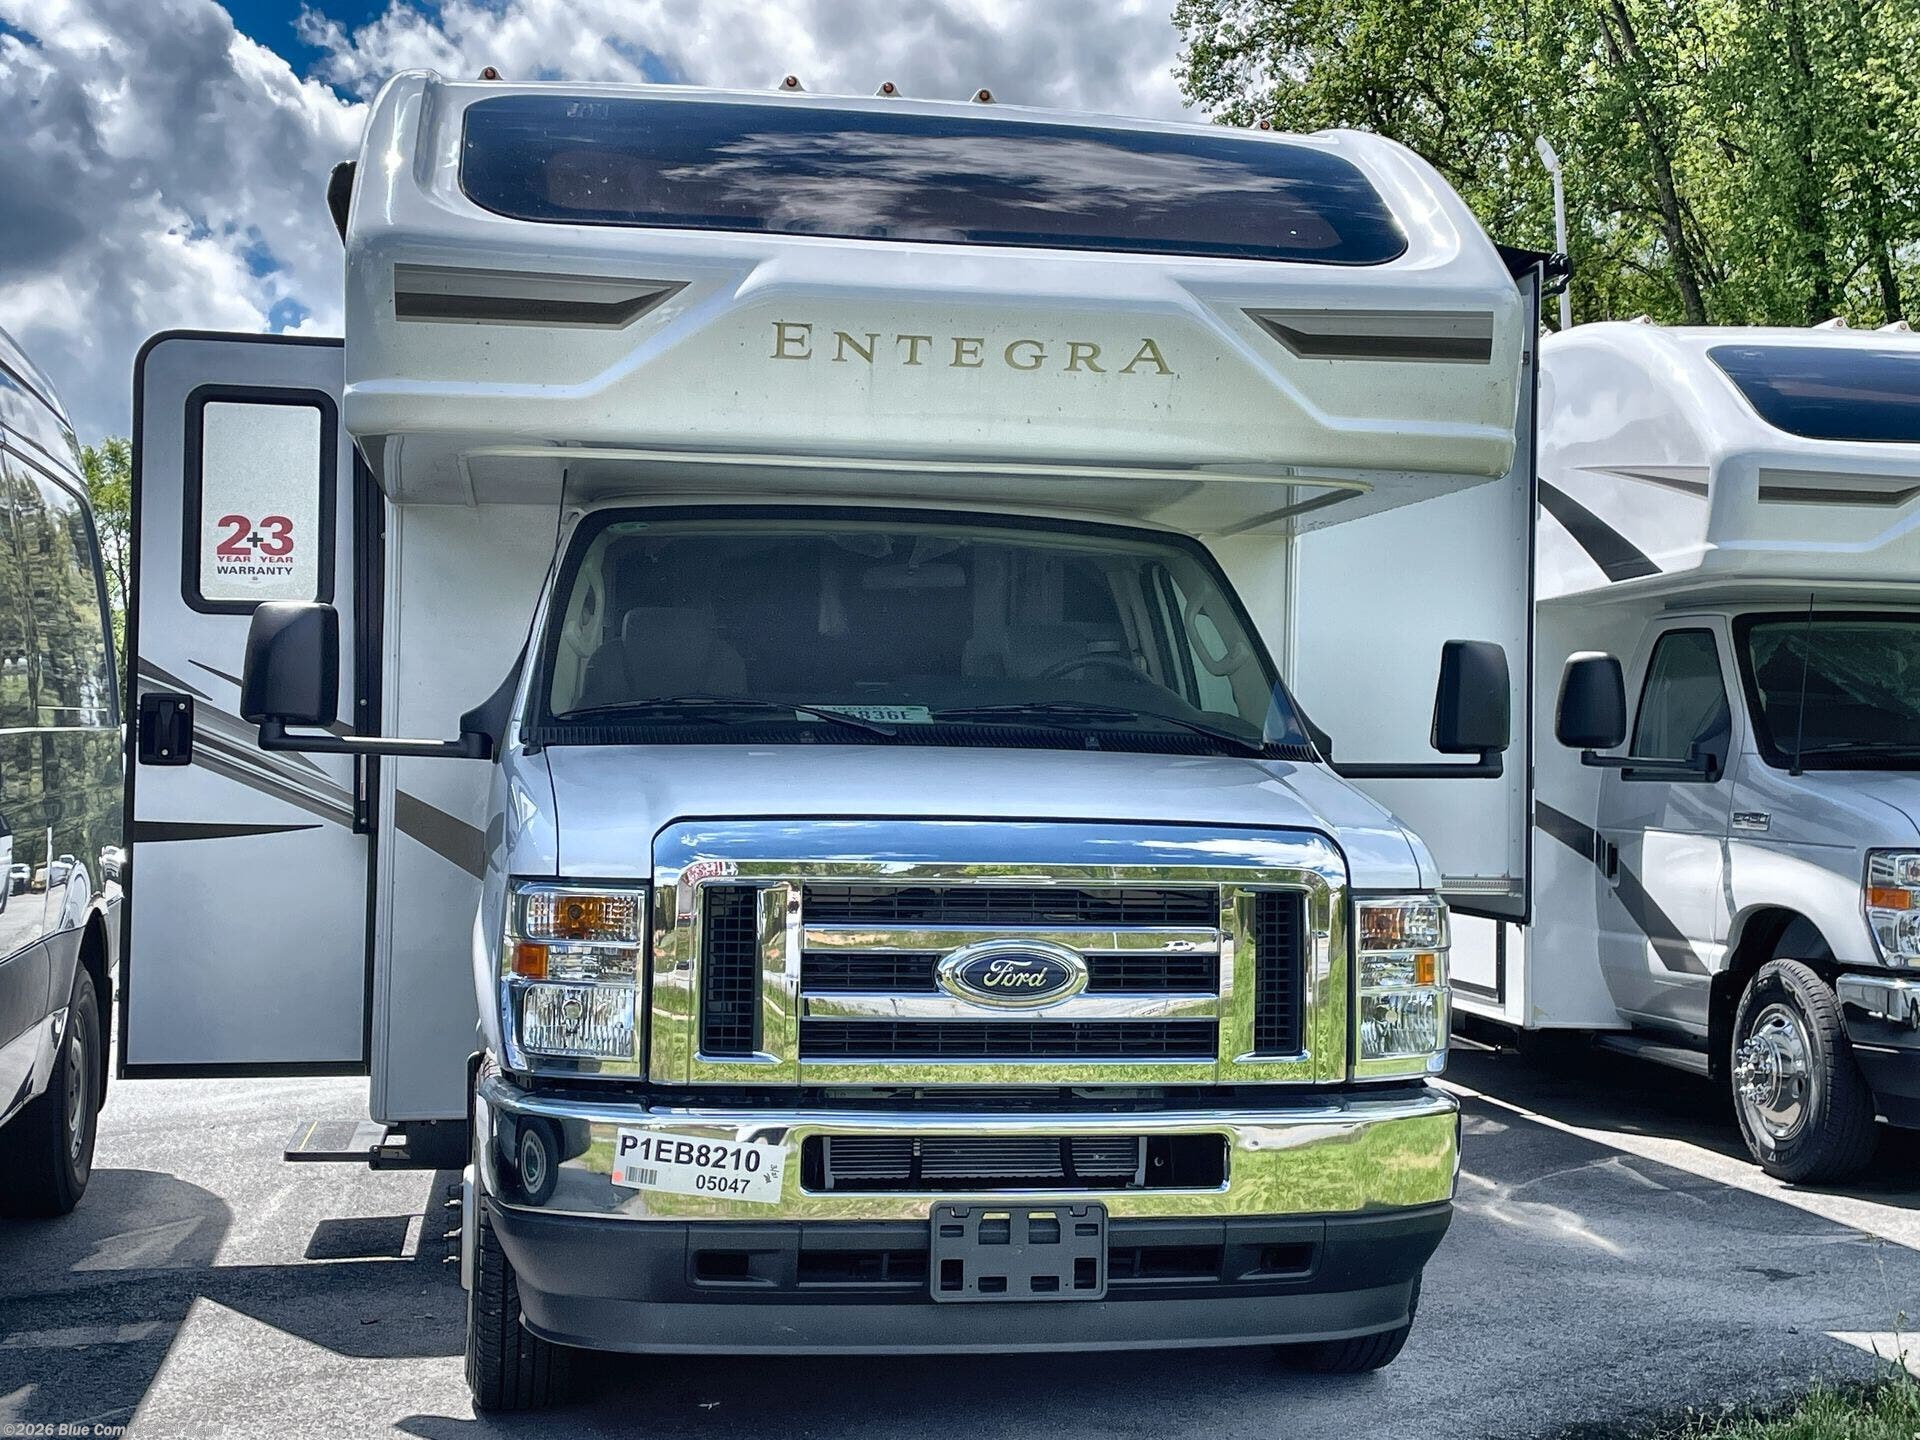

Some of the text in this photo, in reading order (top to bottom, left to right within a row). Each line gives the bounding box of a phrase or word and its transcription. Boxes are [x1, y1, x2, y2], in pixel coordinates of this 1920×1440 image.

[770, 321, 1175, 375] ENTEGRA
[216, 565, 293, 576] WARRANTY
[217, 555, 293, 564] YEAR YEAR
[983, 959, 1048, 987] Ford
[620, 1134, 761, 1172] P1EB8210
[696, 1174, 750, 1194] 05047
